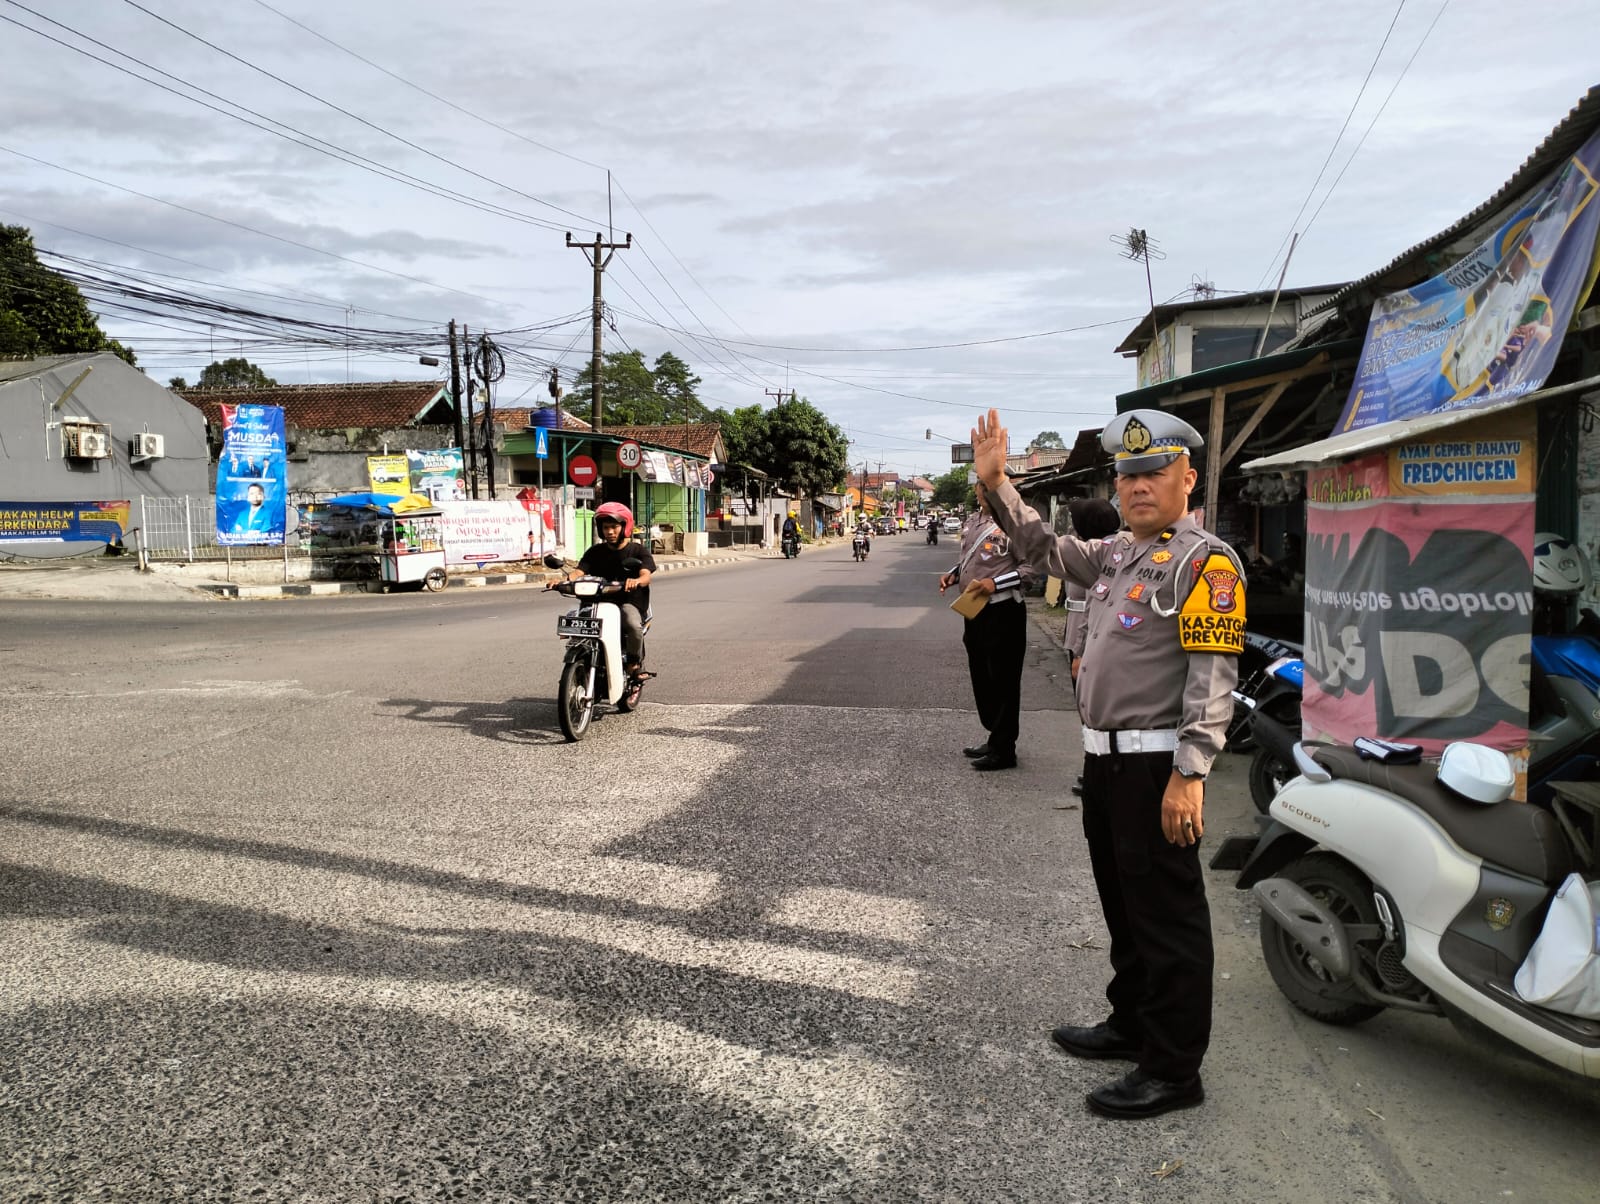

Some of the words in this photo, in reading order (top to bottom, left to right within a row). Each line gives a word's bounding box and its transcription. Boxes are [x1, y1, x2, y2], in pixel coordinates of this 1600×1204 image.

[1449, 260, 1493, 290] KUOTA
[230, 431, 272, 443] MUSDA
[622, 448, 636, 461] 30
[1399, 445, 1430, 459] AYAM
[1476, 442, 1520, 455] RAHAYU
[1403, 459, 1516, 484] FREDCHICKEN
[1320, 474, 1372, 503] Chicken
[41, 510, 74, 519] HELM
[1281, 801, 1330, 828] SCOOPY
